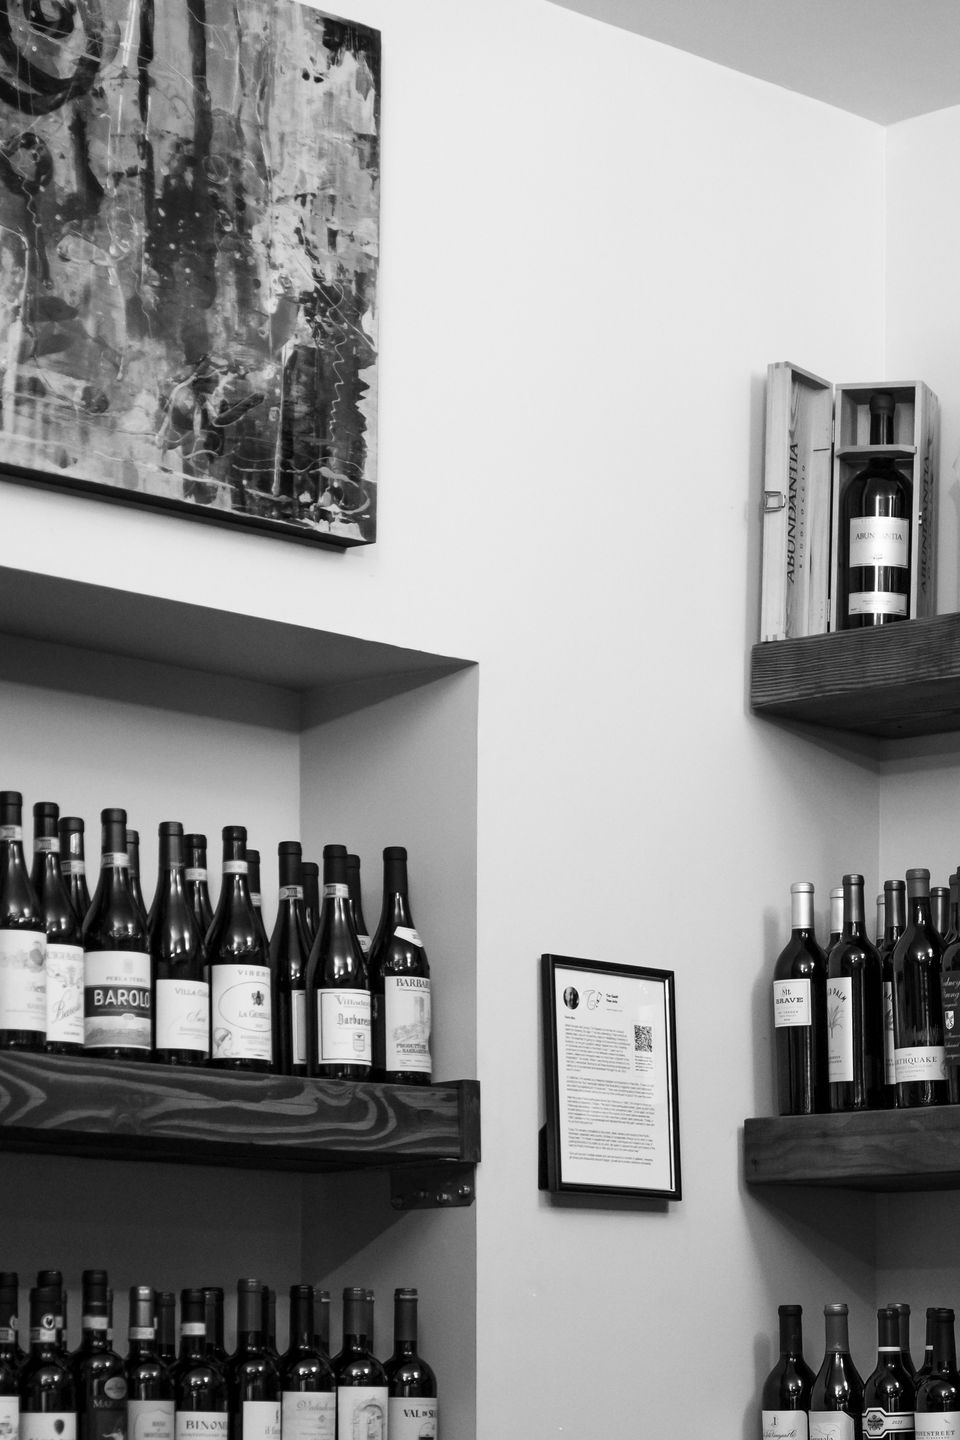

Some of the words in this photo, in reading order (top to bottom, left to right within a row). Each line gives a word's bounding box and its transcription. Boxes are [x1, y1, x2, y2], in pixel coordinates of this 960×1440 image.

[786, 442, 799, 584] ABUNDANTIA
[93, 989, 151, 1008] BAROLO
[775, 996, 804, 1005] BRAVE
[403, 1408, 421, 1418] VAL
